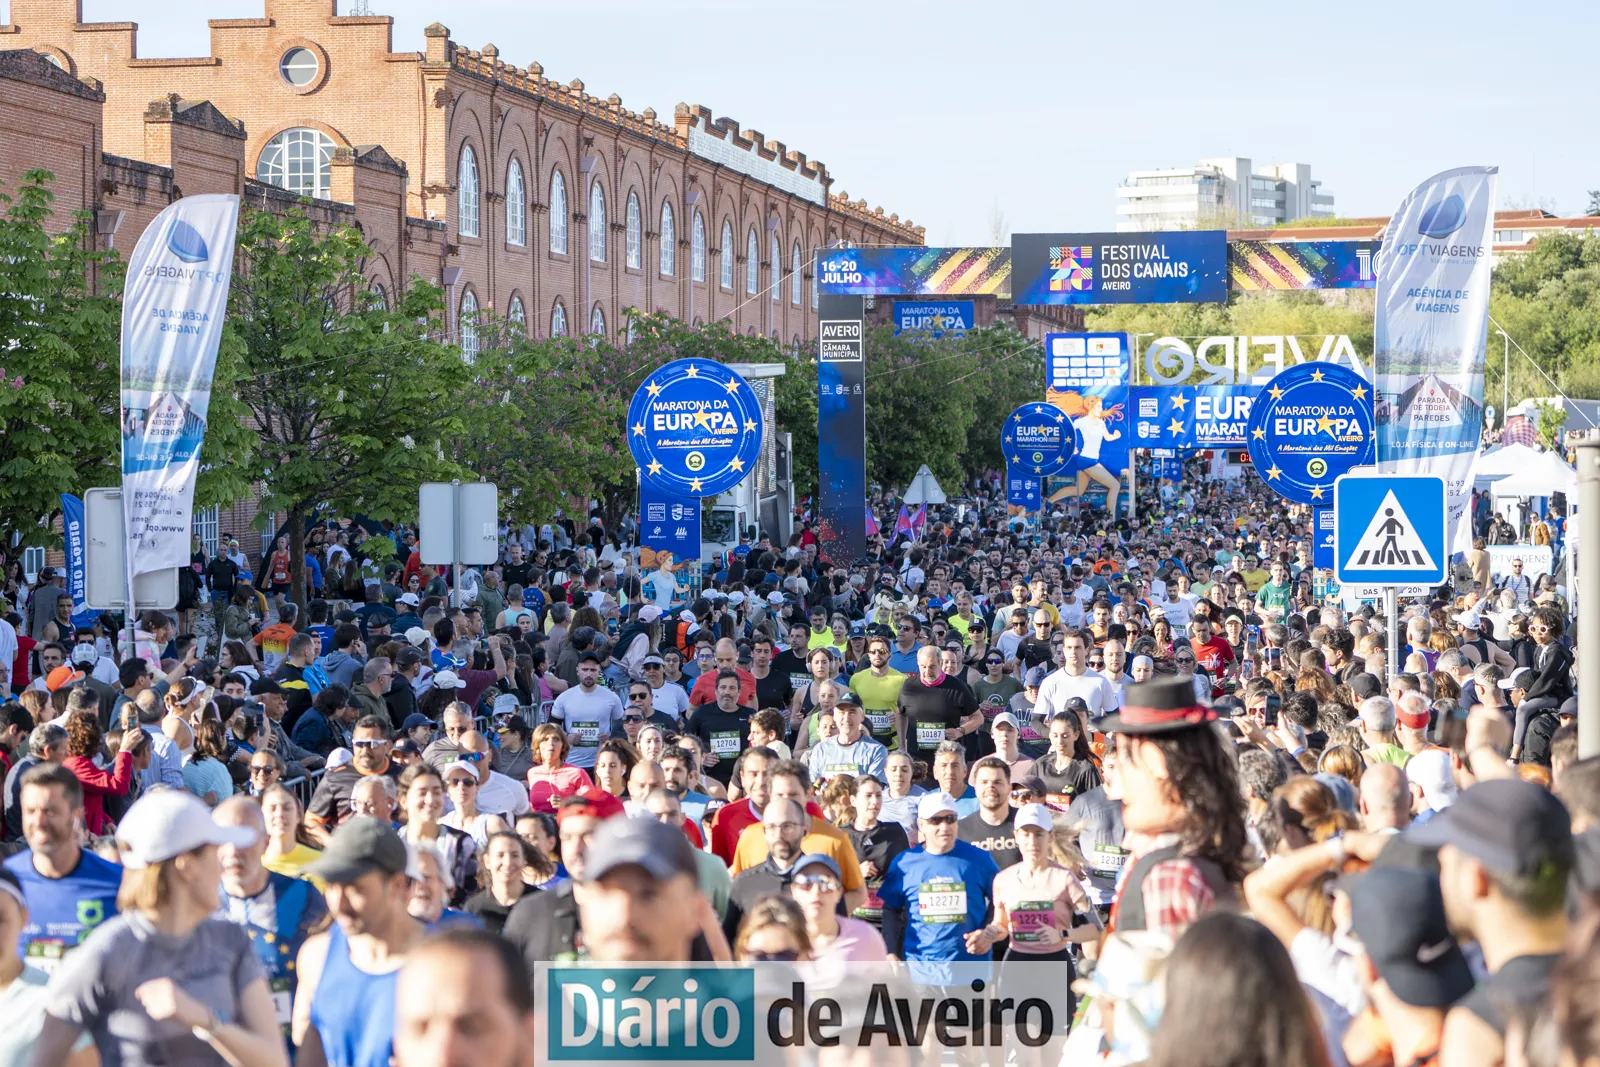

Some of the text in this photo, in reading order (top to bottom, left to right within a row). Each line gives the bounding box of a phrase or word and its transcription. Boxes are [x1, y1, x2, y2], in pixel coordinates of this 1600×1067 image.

[1101, 244, 1170, 260] FESTIVAL
[821, 260, 857, 272] 16-20
[1101, 261, 1188, 279] DOS CANAIS
[821, 273, 862, 284] JULHO
[1101, 280, 1131, 291] AVEIRO
[1406, 286, 1469, 299] AGÊNCIA DE
[901, 306, 960, 314] MARATONA DA
[1415, 302, 1460, 313] VIAGENS
[1417, 396, 1447, 404] PARADA
[653, 400, 729, 411] MARATONA DA
[1275, 406, 1355, 416] MARATONA DA
[1413, 414, 1450, 422] PAREDES
[1362, 588, 1378, 596] DAS
[922, 730, 942, 738] 10187
[717, 739, 737, 748] 12704
[1101, 856, 1126, 866] 12310
[930, 896, 960, 906] 12277
[1019, 913, 1048, 924] 12276
